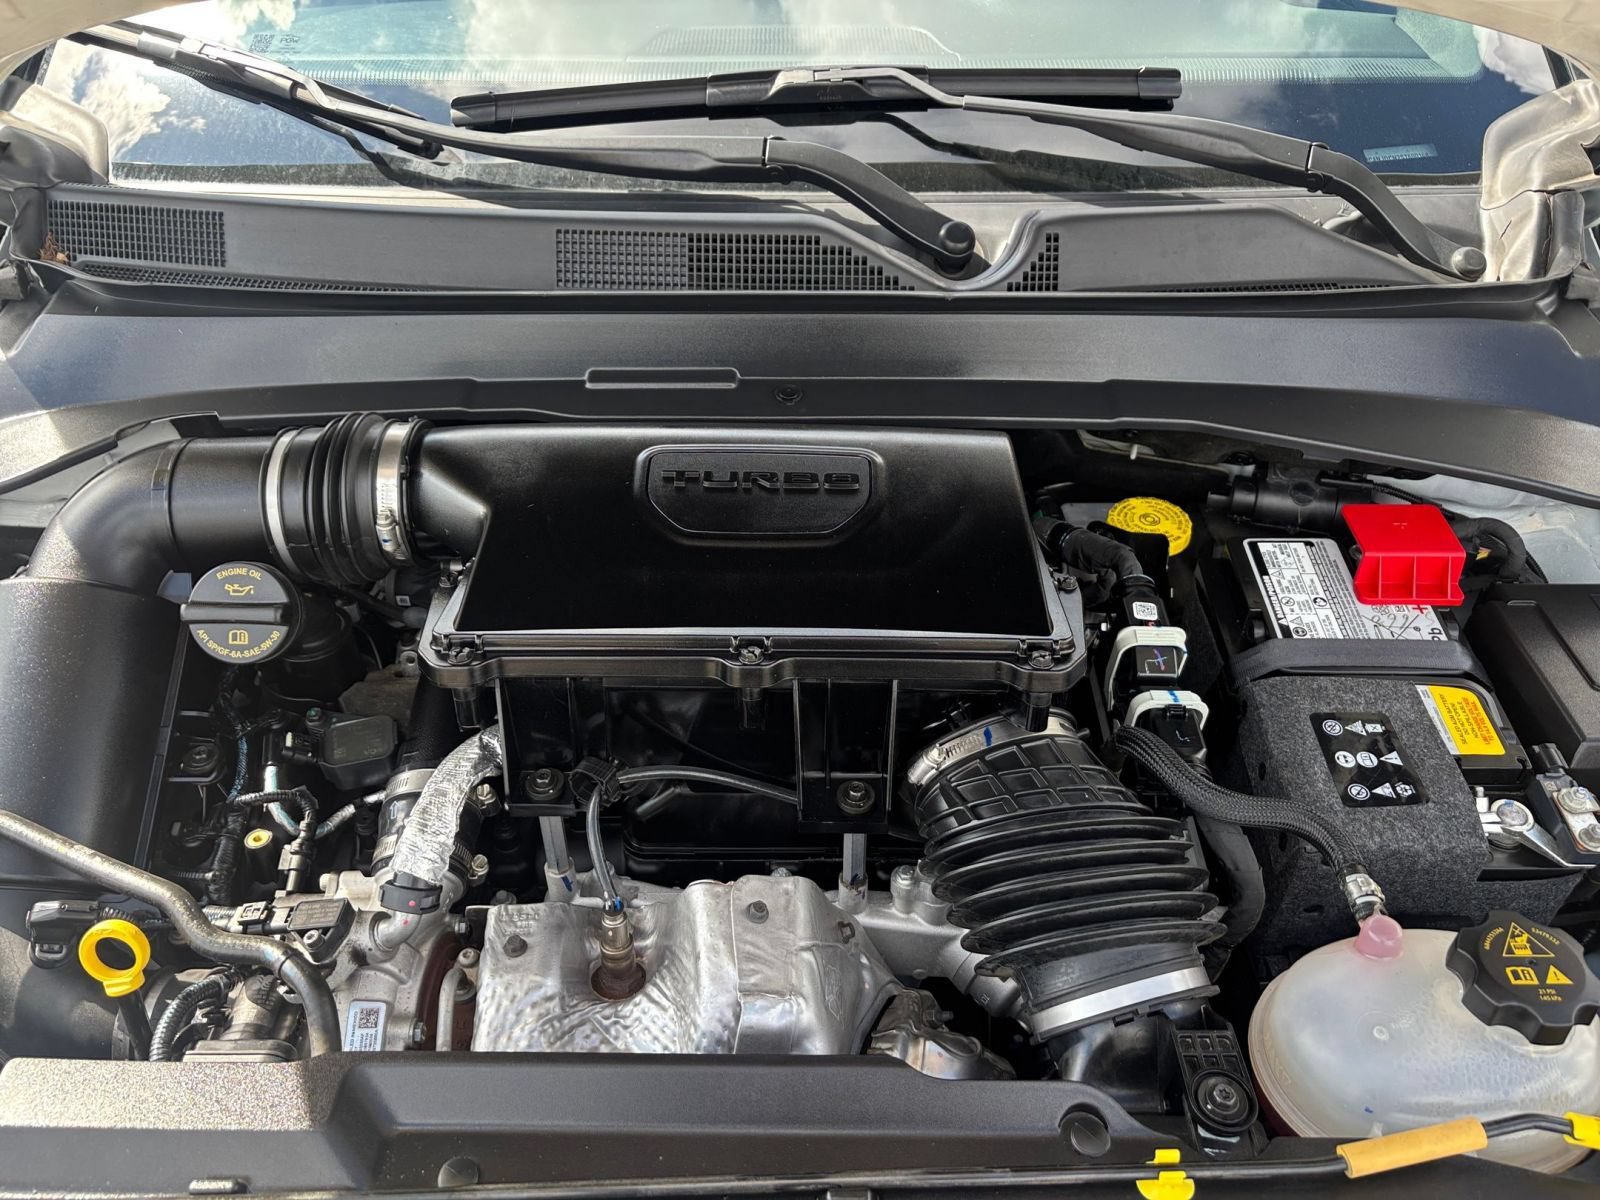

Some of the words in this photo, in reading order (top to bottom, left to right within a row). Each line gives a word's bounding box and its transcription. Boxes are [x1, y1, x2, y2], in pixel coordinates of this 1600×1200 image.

[216, 567, 248, 580] ENGINE
[249, 569, 262, 581] OIL
[196, 629, 208, 643] API
